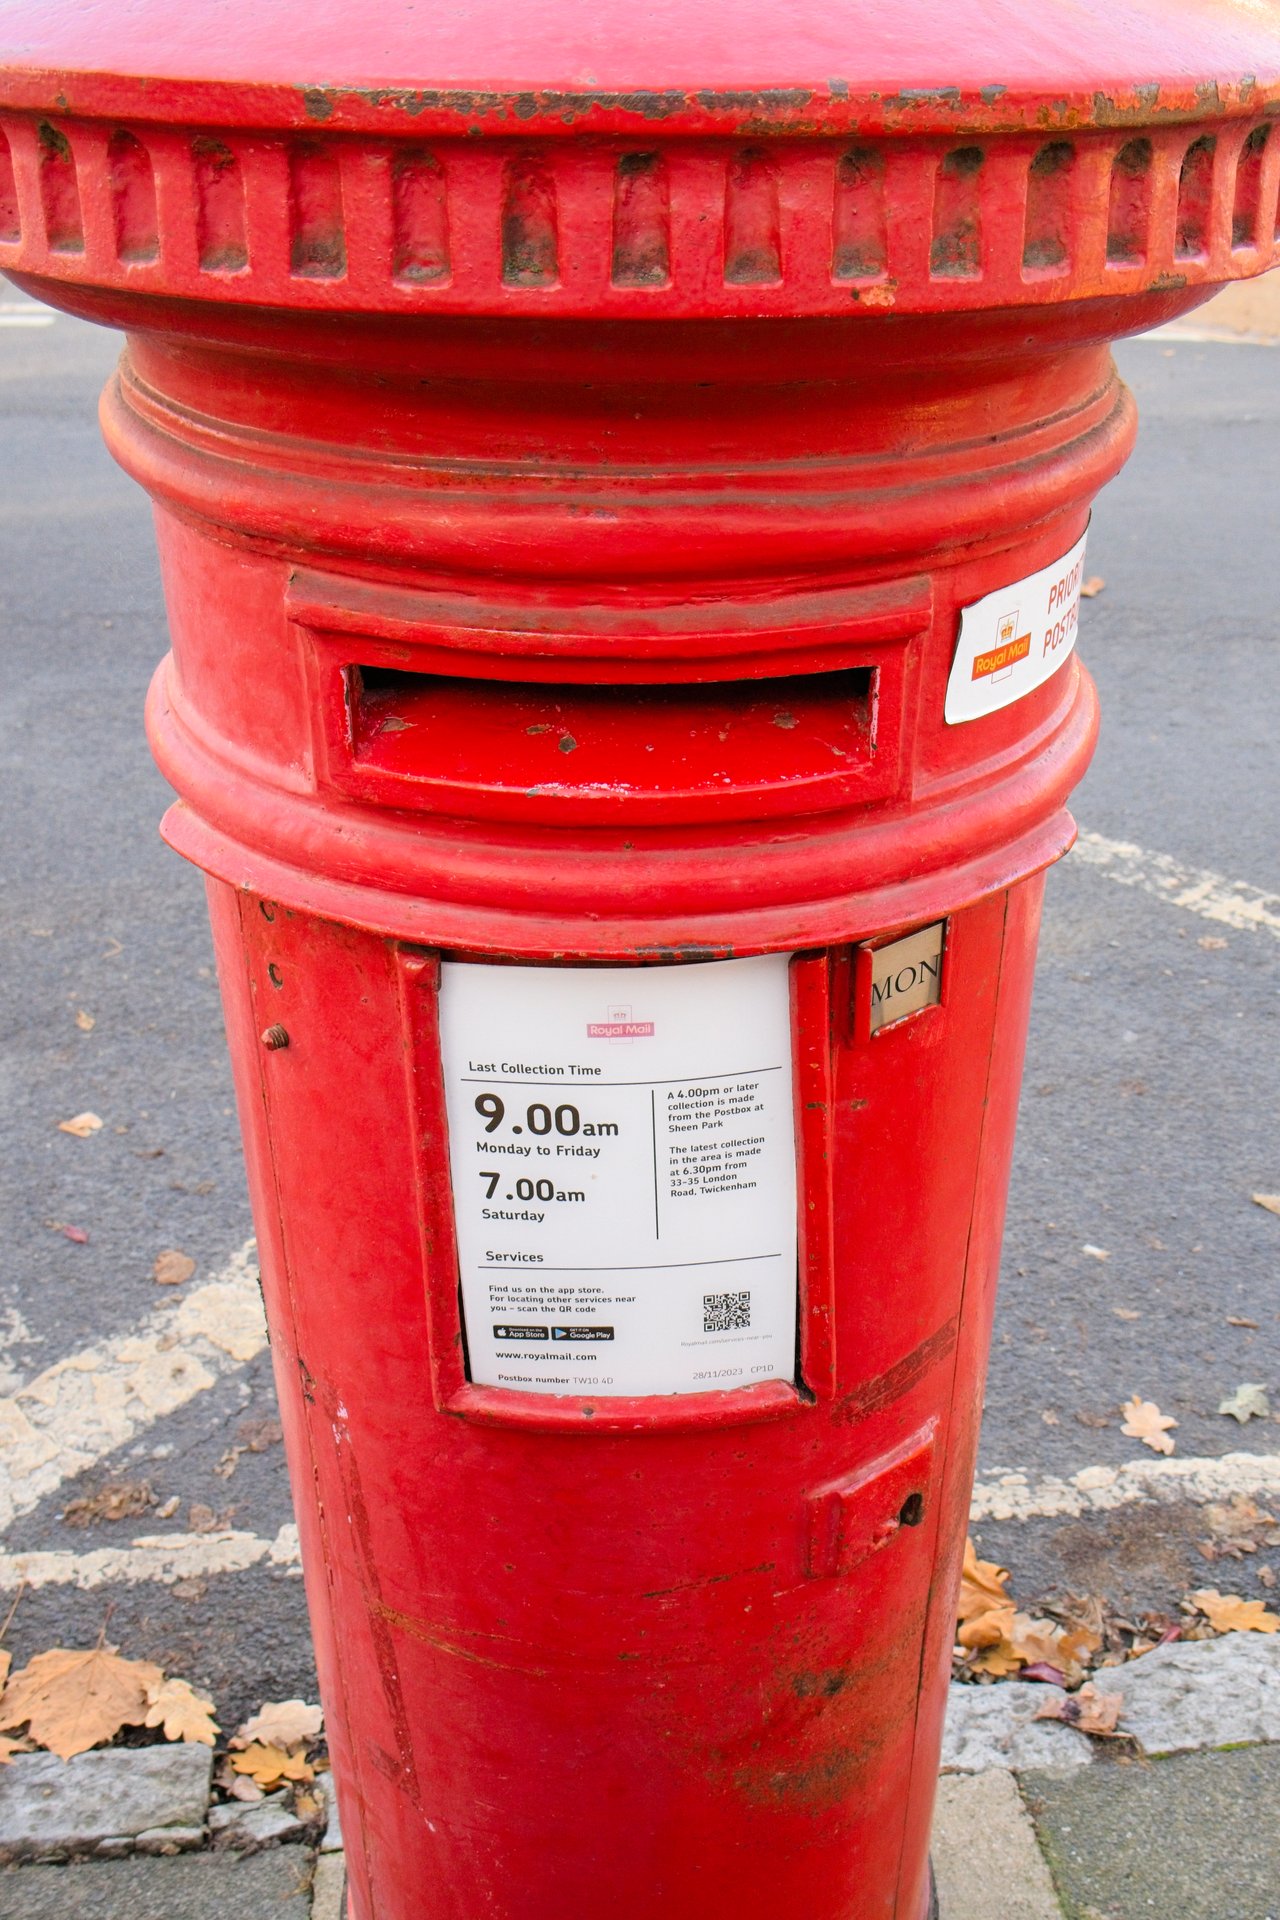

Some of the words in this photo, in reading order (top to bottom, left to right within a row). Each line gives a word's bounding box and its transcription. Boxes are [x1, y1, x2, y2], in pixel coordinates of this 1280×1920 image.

[976, 649, 1007, 673] Royal
[1008, 639, 1029, 660] Mail
[871, 954, 942, 1006] MON
[590, 1025, 623, 1037] Royal
[626, 1024, 651, 1034] Mail
[469, 1062, 497, 1073] Last
[501, 1063, 564, 1075] Collection
[569, 1065, 601, 1076] Time
[667, 1092, 674, 1100] A
[678, 1088, 720, 1099] 4.00pm
[737, 1083, 759, 1092] later
[668, 1099, 714, 1111] collection
[717, 1098, 725, 1106] is
[729, 1094, 755, 1104] made
[474, 1093, 619, 1137] 9.00am
[668, 1112, 692, 1121] from
[695, 1111, 711, 1119] the
[715, 1105, 751, 1117] Postbox
[669, 1123, 698, 1133] Sheen
[702, 1121, 723, 1129] Park
[477, 1142, 531, 1157] Monday
[536, 1145, 551, 1156] to
[556, 1145, 601, 1159] Friday
[669, 1145, 687, 1154] The
[691, 1142, 717, 1152] latest
[721, 1136, 765, 1148] collection
[670, 1157, 679, 1165] in
[682, 1155, 698, 1163] the
[701, 1154, 722, 1162] area
[725, 1151, 733, 1159] is
[736, 1147, 762, 1157] made
[683, 1165, 722, 1175] 6.30pm
[725, 1161, 747, 1170] from
[703, 1173, 737, 1184] London
[479, 1172, 585, 1202] 7.00am
[671, 1188, 697, 1197] Road,
[700, 1181, 757, 1194] Twickenham
[482, 1209, 545, 1223] Saturday
[486, 1251, 544, 1263] Services
[489, 1285, 508, 1293] Find
[508, 1296, 544, 1304] locating
[596, 1331, 611, 1339] Play
[496, 1351, 597, 1361] www.royalmail.com
[498, 1374, 532, 1382] Postbox
[536, 1376, 571, 1384] number
[692, 1368, 743, 1380] 28/11/2023
